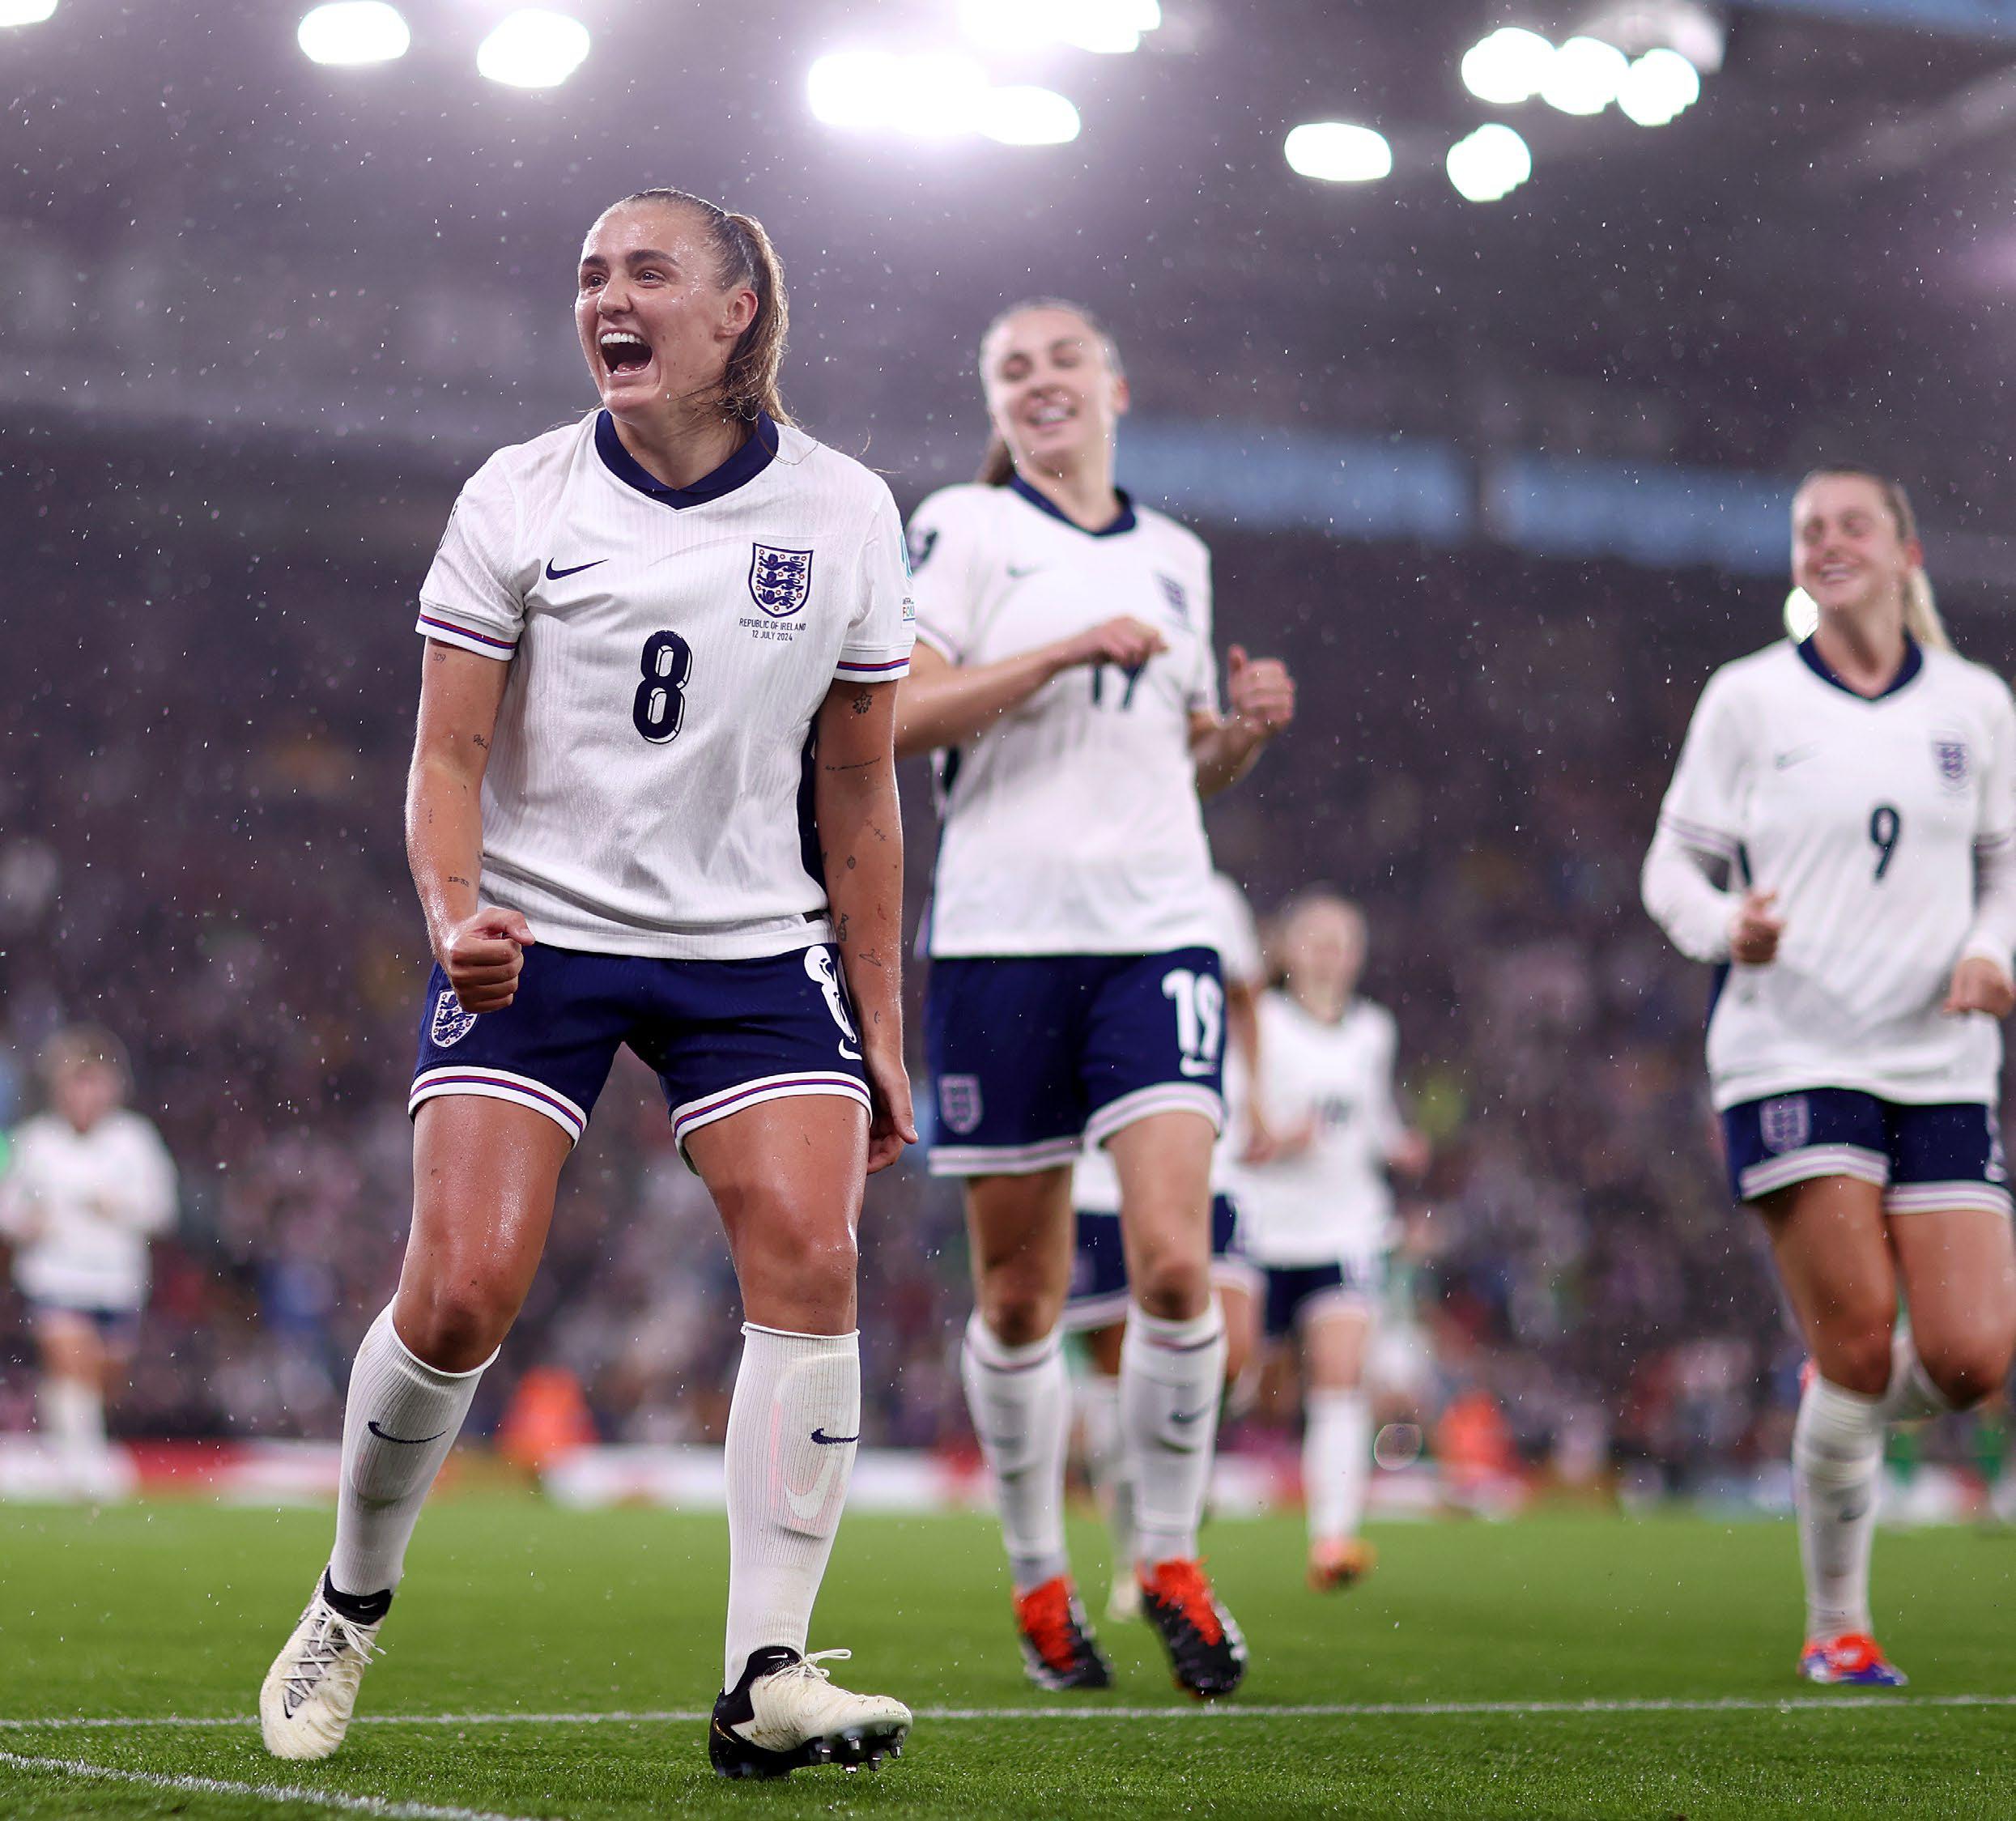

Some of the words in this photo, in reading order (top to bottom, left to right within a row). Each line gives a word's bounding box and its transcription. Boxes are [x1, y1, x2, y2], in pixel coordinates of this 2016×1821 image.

[739, 617, 769, 629] REPUBLIC
[770, 621, 779, 630] OF
[780, 622, 806, 632] IRELAND
[751, 629, 759, 639] 12
[760, 631, 776, 640] JULY
[776, 632, 793, 641] 2024
[632, 629, 693, 744] 8
[1869, 803, 1901, 883] 9
[1161, 967, 1223, 1059] 19
